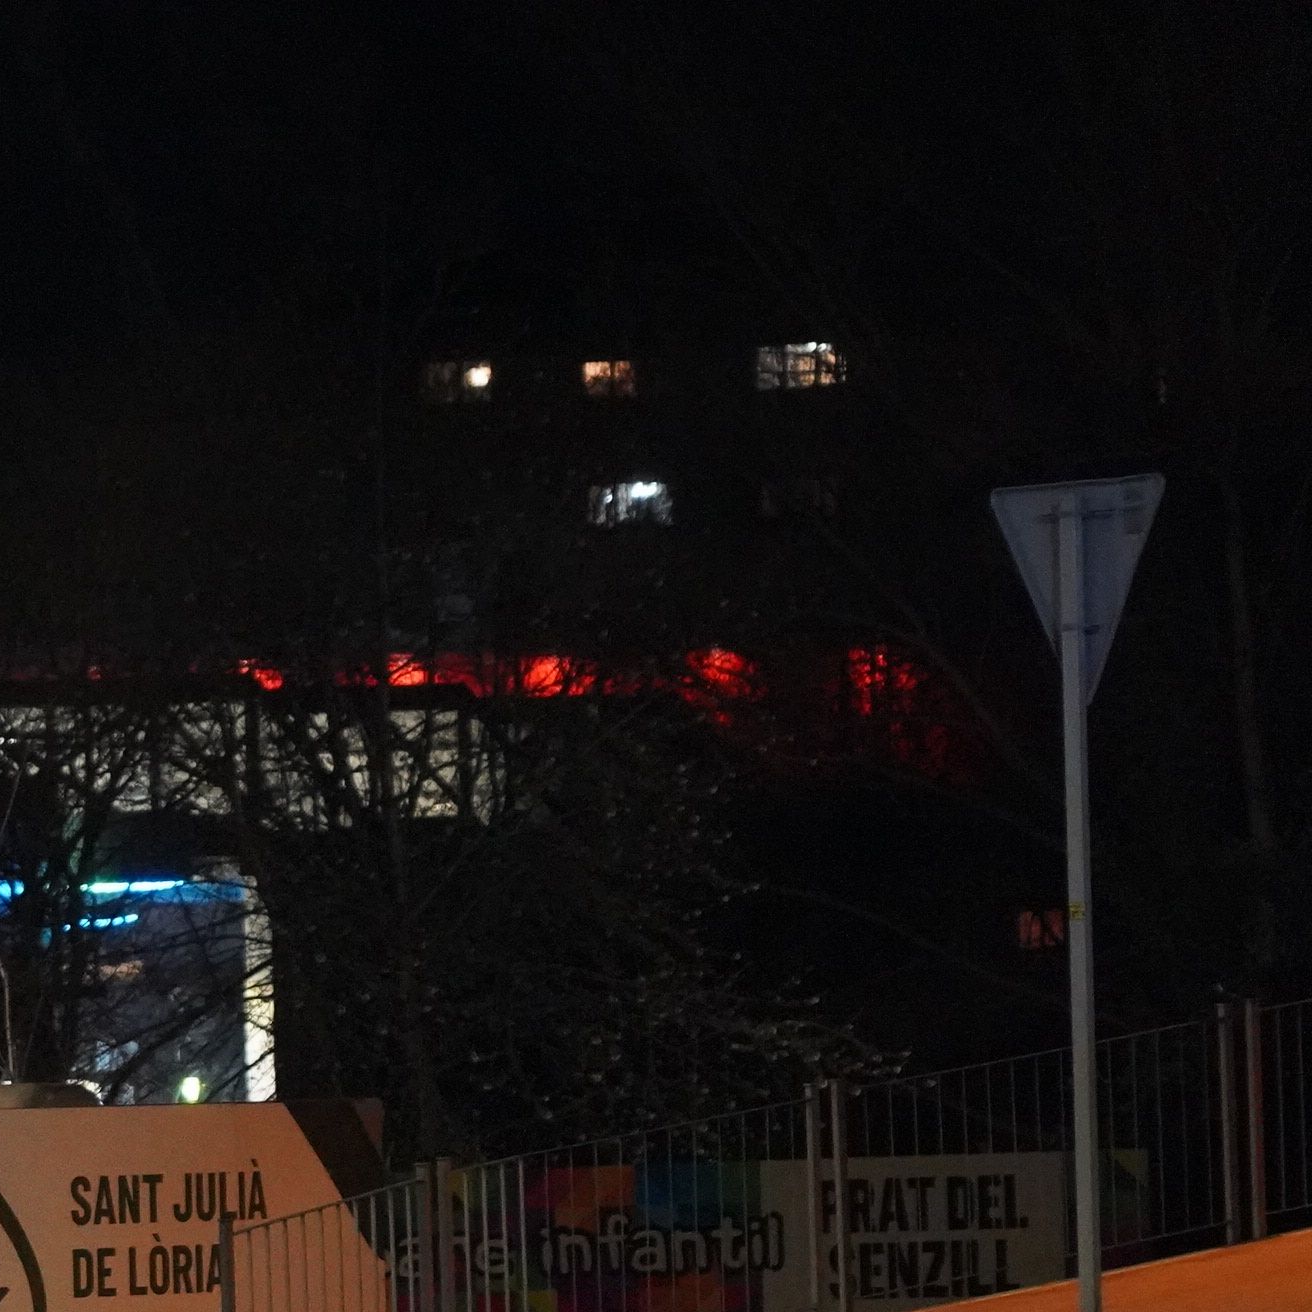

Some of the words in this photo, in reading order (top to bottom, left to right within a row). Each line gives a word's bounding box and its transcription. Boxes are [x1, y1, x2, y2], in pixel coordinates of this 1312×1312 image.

[70, 1173, 164, 1226] SANT
[172, 1158, 268, 1223] JULIÀ
[822, 1176, 936, 1233] PRAT
[947, 1174, 1029, 1230] DEL
[72, 1247, 117, 1299] DE
[128, 1233, 222, 1296] LÒRIA
[541, 1212, 782, 1274] infantil
[830, 1239, 1020, 1298] SENZILL
